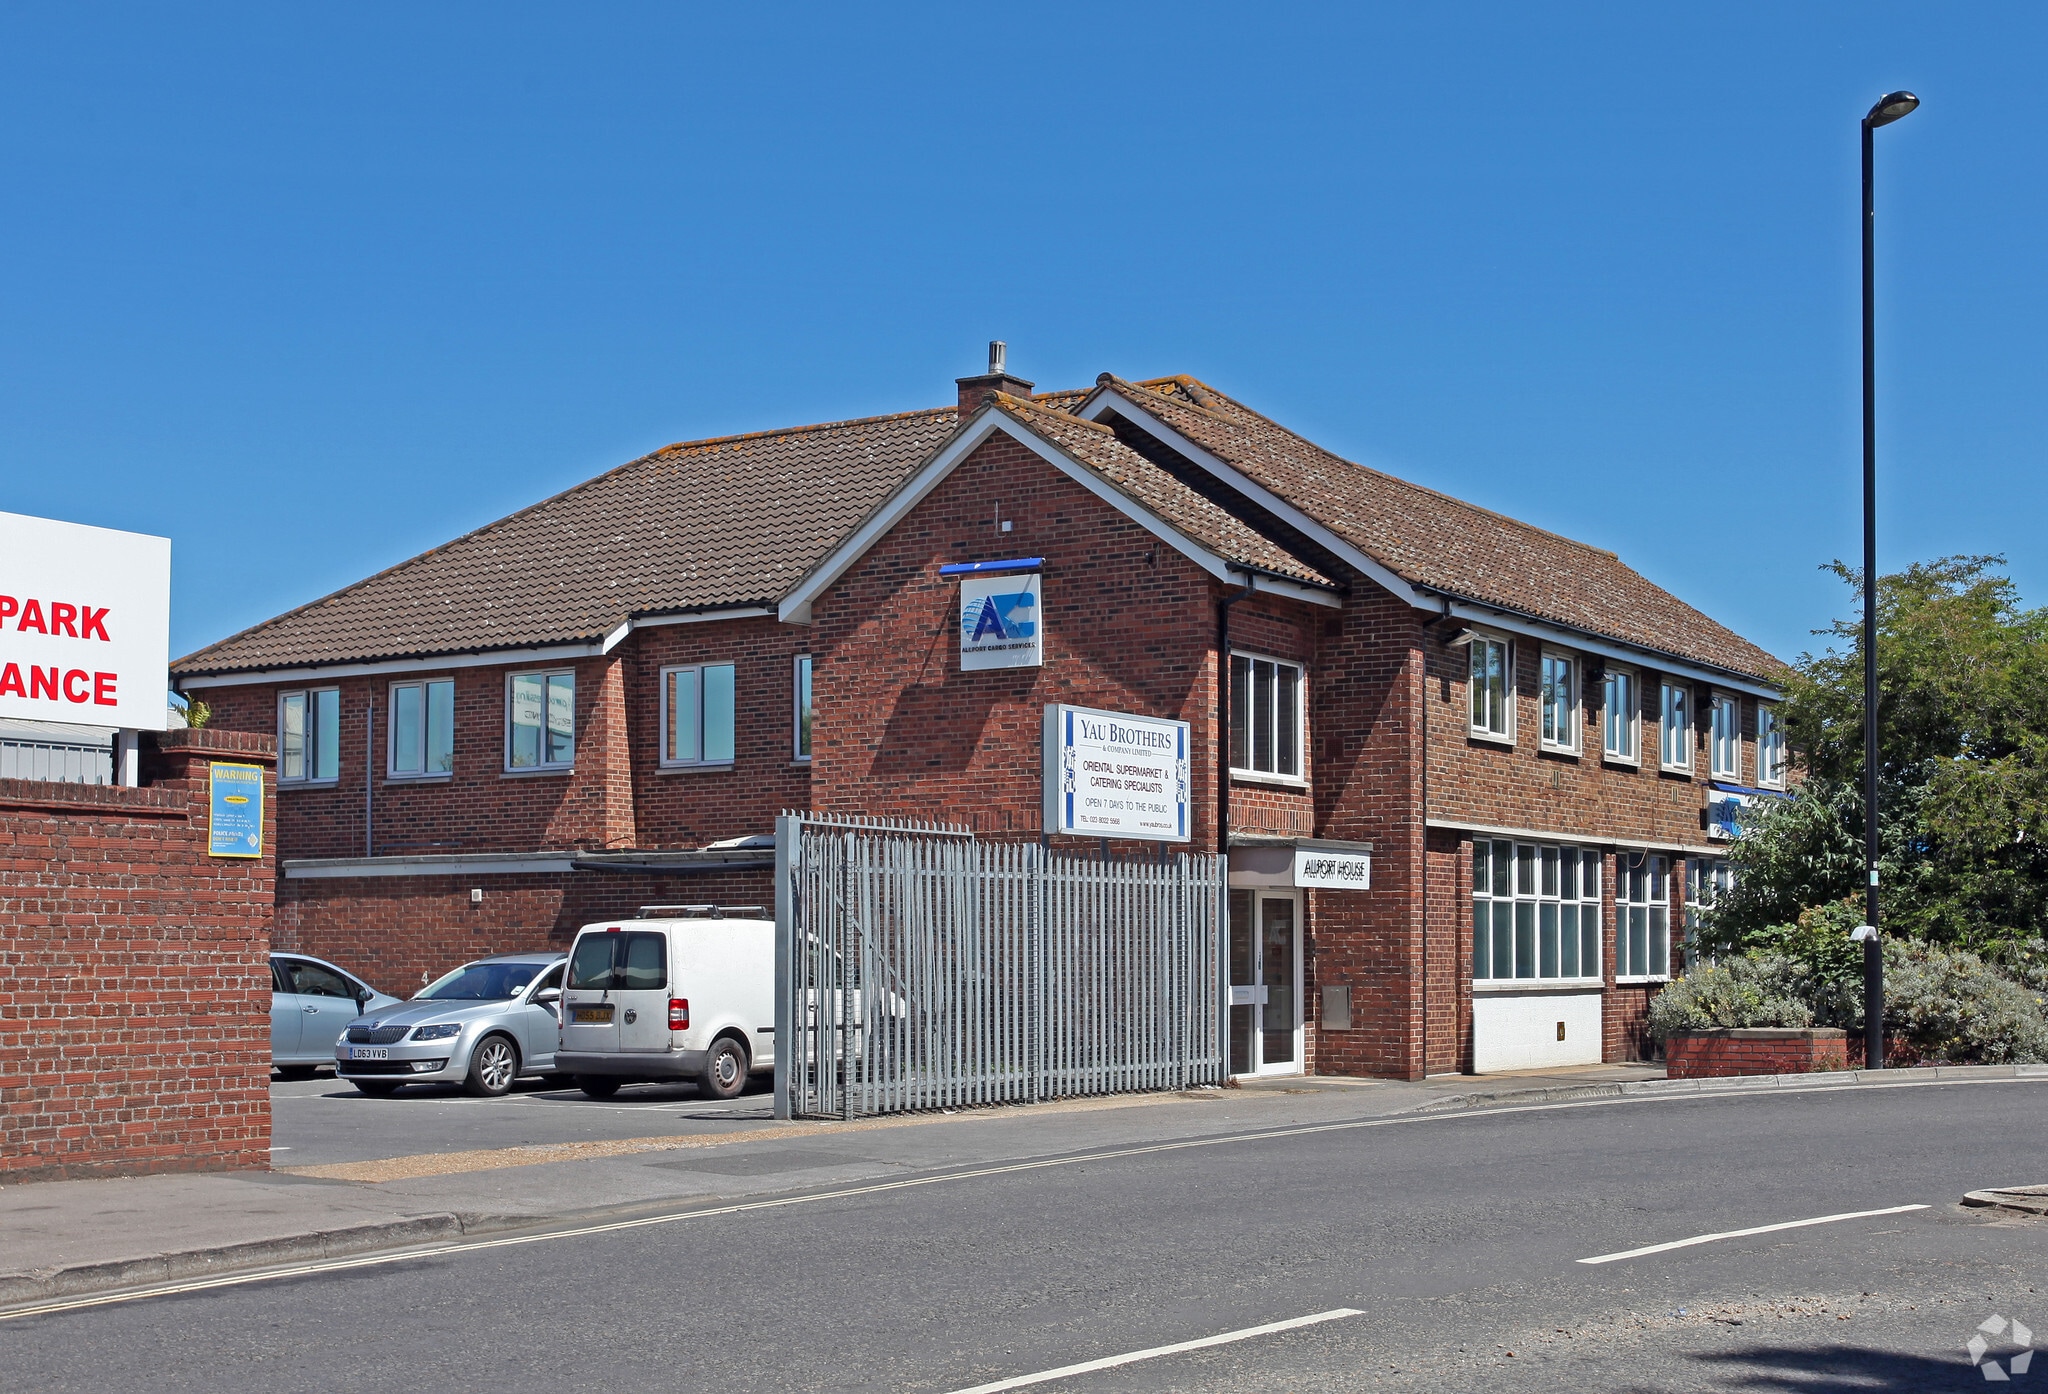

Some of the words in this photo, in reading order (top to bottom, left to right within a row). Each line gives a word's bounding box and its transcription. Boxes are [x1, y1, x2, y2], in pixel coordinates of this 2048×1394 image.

[0, 594, 111, 642] PARK
[962, 645, 987, 653] ALLPORT
[0, 662, 118, 706] ANCE
[1081, 719, 1106, 741] YAU
[1109, 723, 1172, 749] BROTHERS
[1107, 745, 1132, 755] COMPANY
[1132, 748, 1152, 757] LIMITED
[214, 769, 258, 781] WARNING
[1083, 760, 1114, 774] ORIENTAL
[1116, 764, 1162, 779] SUPERMARKET
[1090, 776, 1122, 789] CATERING
[1124, 780, 1163, 794] SPECIALISTS
[1085, 797, 1102, 808] OPEN
[1109, 800, 1124, 809] DAYS
[1126, 801, 1134, 810] TO
[1135, 802, 1146, 811] THE
[1148, 804, 1168, 813] PUBLIC
[1304, 859, 1336, 876] ALLPORT
[1338, 861, 1365, 877] HOUSE
[421, 970, 429, 984] 4
